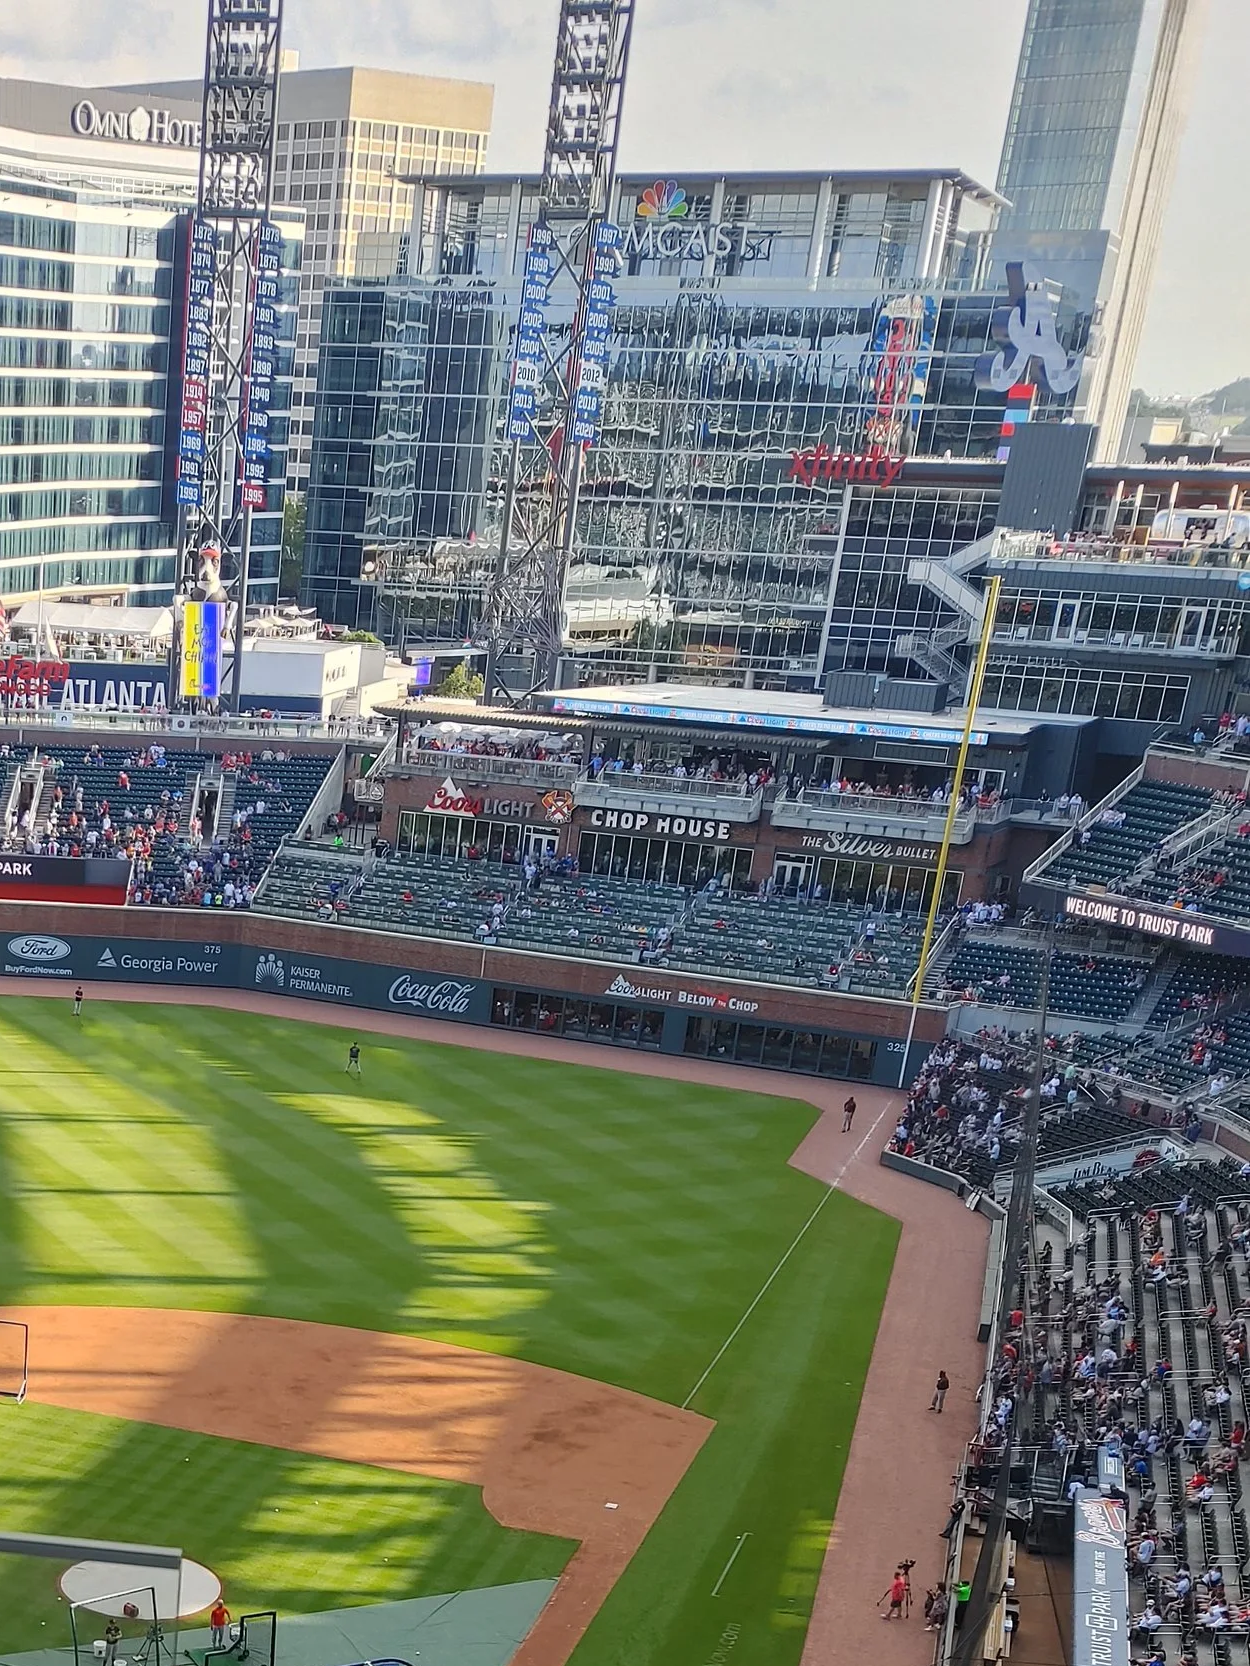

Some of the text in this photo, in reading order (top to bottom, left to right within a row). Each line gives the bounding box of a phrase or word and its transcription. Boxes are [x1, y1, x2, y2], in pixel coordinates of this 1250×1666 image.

[73, 100, 128, 139] OMNI
[194, 225, 212, 240] 1872
[533, 228, 551, 245] 1996
[599, 227, 617, 244] 1997
[259, 253, 278, 269] 1875
[191, 278, 209, 294] 1877
[526, 284, 546, 300] 2000
[592, 284, 611, 301] 2001
[256, 307, 274, 323] 1891
[523, 312, 542, 328] 2002
[589, 312, 608, 329] 2003
[254, 333, 273, 350] 1893
[520, 339, 540, 356] 2004
[585, 340, 605, 356] 2005
[187, 357, 205, 373] 1897
[252, 359, 272, 375] 1898
[518, 366, 536, 382] 2010
[582, 366, 599, 382] 2012
[185, 383, 203, 399] 1914
[184, 410, 202, 426] 1957
[249, 411, 268, 427] 1958
[575, 421, 594, 437] 2020
[182, 435, 201, 451] 1969
[181, 460, 199, 476] 1991
[246, 462, 265, 478] 1992
[788, 442, 907, 488] xfinity
[180, 485, 198, 501] 1993
[244, 487, 263, 503] 1995
[61, 679, 168, 712] ATLANTA
[428, 787, 481, 815] Coors
[484, 797, 535, 818] LIGHT
[591, 809, 648, 831] CHOP
[657, 817, 730, 840] HOUSE
[802, 831, 937, 859] THE Silver BULLET
[1066, 896, 1215, 945] WELCOME TO TRUIST PARK
[20, 938, 59, 958] Ford
[204, 946, 221, 954] 375
[5, 964, 73, 977] BuyFordNow.com
[121, 954, 218, 973] Georgia Power
[290, 965, 321, 979] KAISER
[290, 978, 351, 997] PERMANENTE
[641, 988, 672, 1000] LIGHT
[678, 991, 717, 1007] BELOW
[728, 998, 758, 1012] CHOP
[886, 1042, 906, 1054] 325
[1094, 1550, 1107, 1561] THE
[1094, 1569, 1107, 1586] HOME
[1092, 1588, 1111, 1616] PARK
[1092, 1629, 1112, 1666] TRUIST
